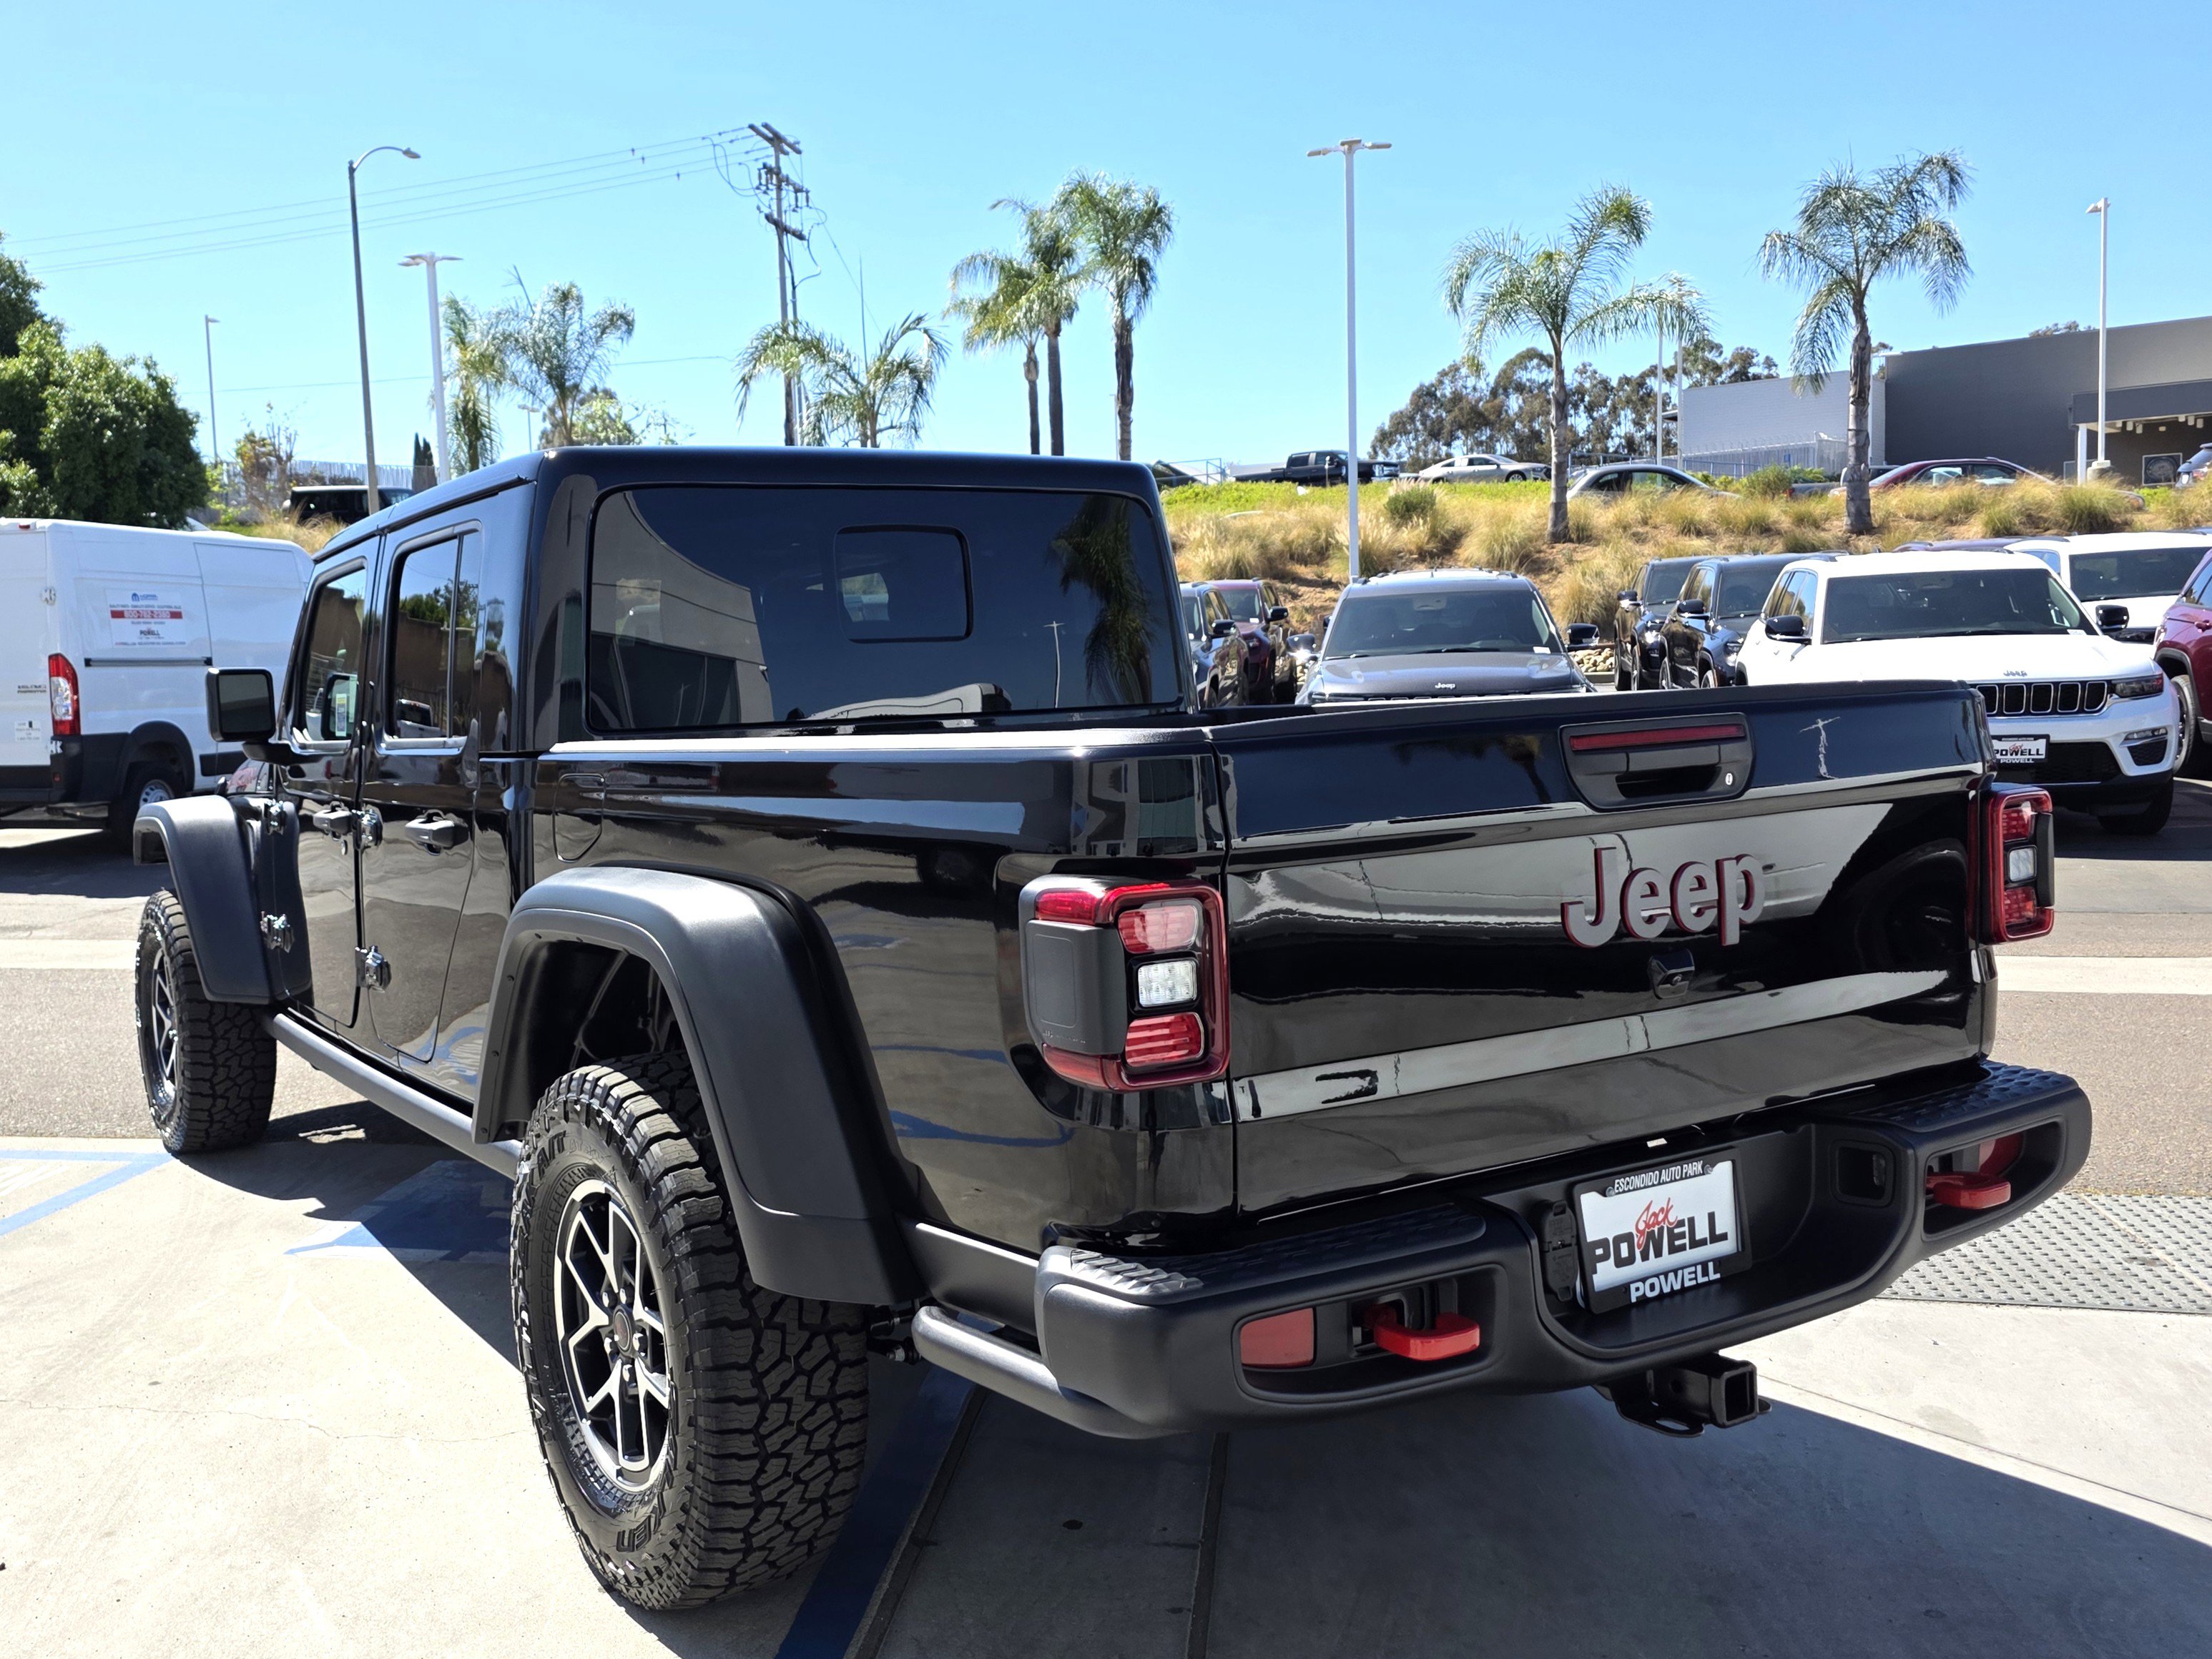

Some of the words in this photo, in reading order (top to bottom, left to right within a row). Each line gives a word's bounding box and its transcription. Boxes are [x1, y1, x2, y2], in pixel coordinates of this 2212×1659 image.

[1560, 846, 1765, 948] Jeep
[1614, 1171, 1659, 1193] ESCONDIDO
[1661, 1165, 1681, 1181] AUTO
[1683, 1161, 1704, 1178] PARK
[1587, 1211, 1729, 1276] POWELL
[1635, 1197, 1678, 1251] Jack
[1629, 1261, 1721, 1303] POWELL
